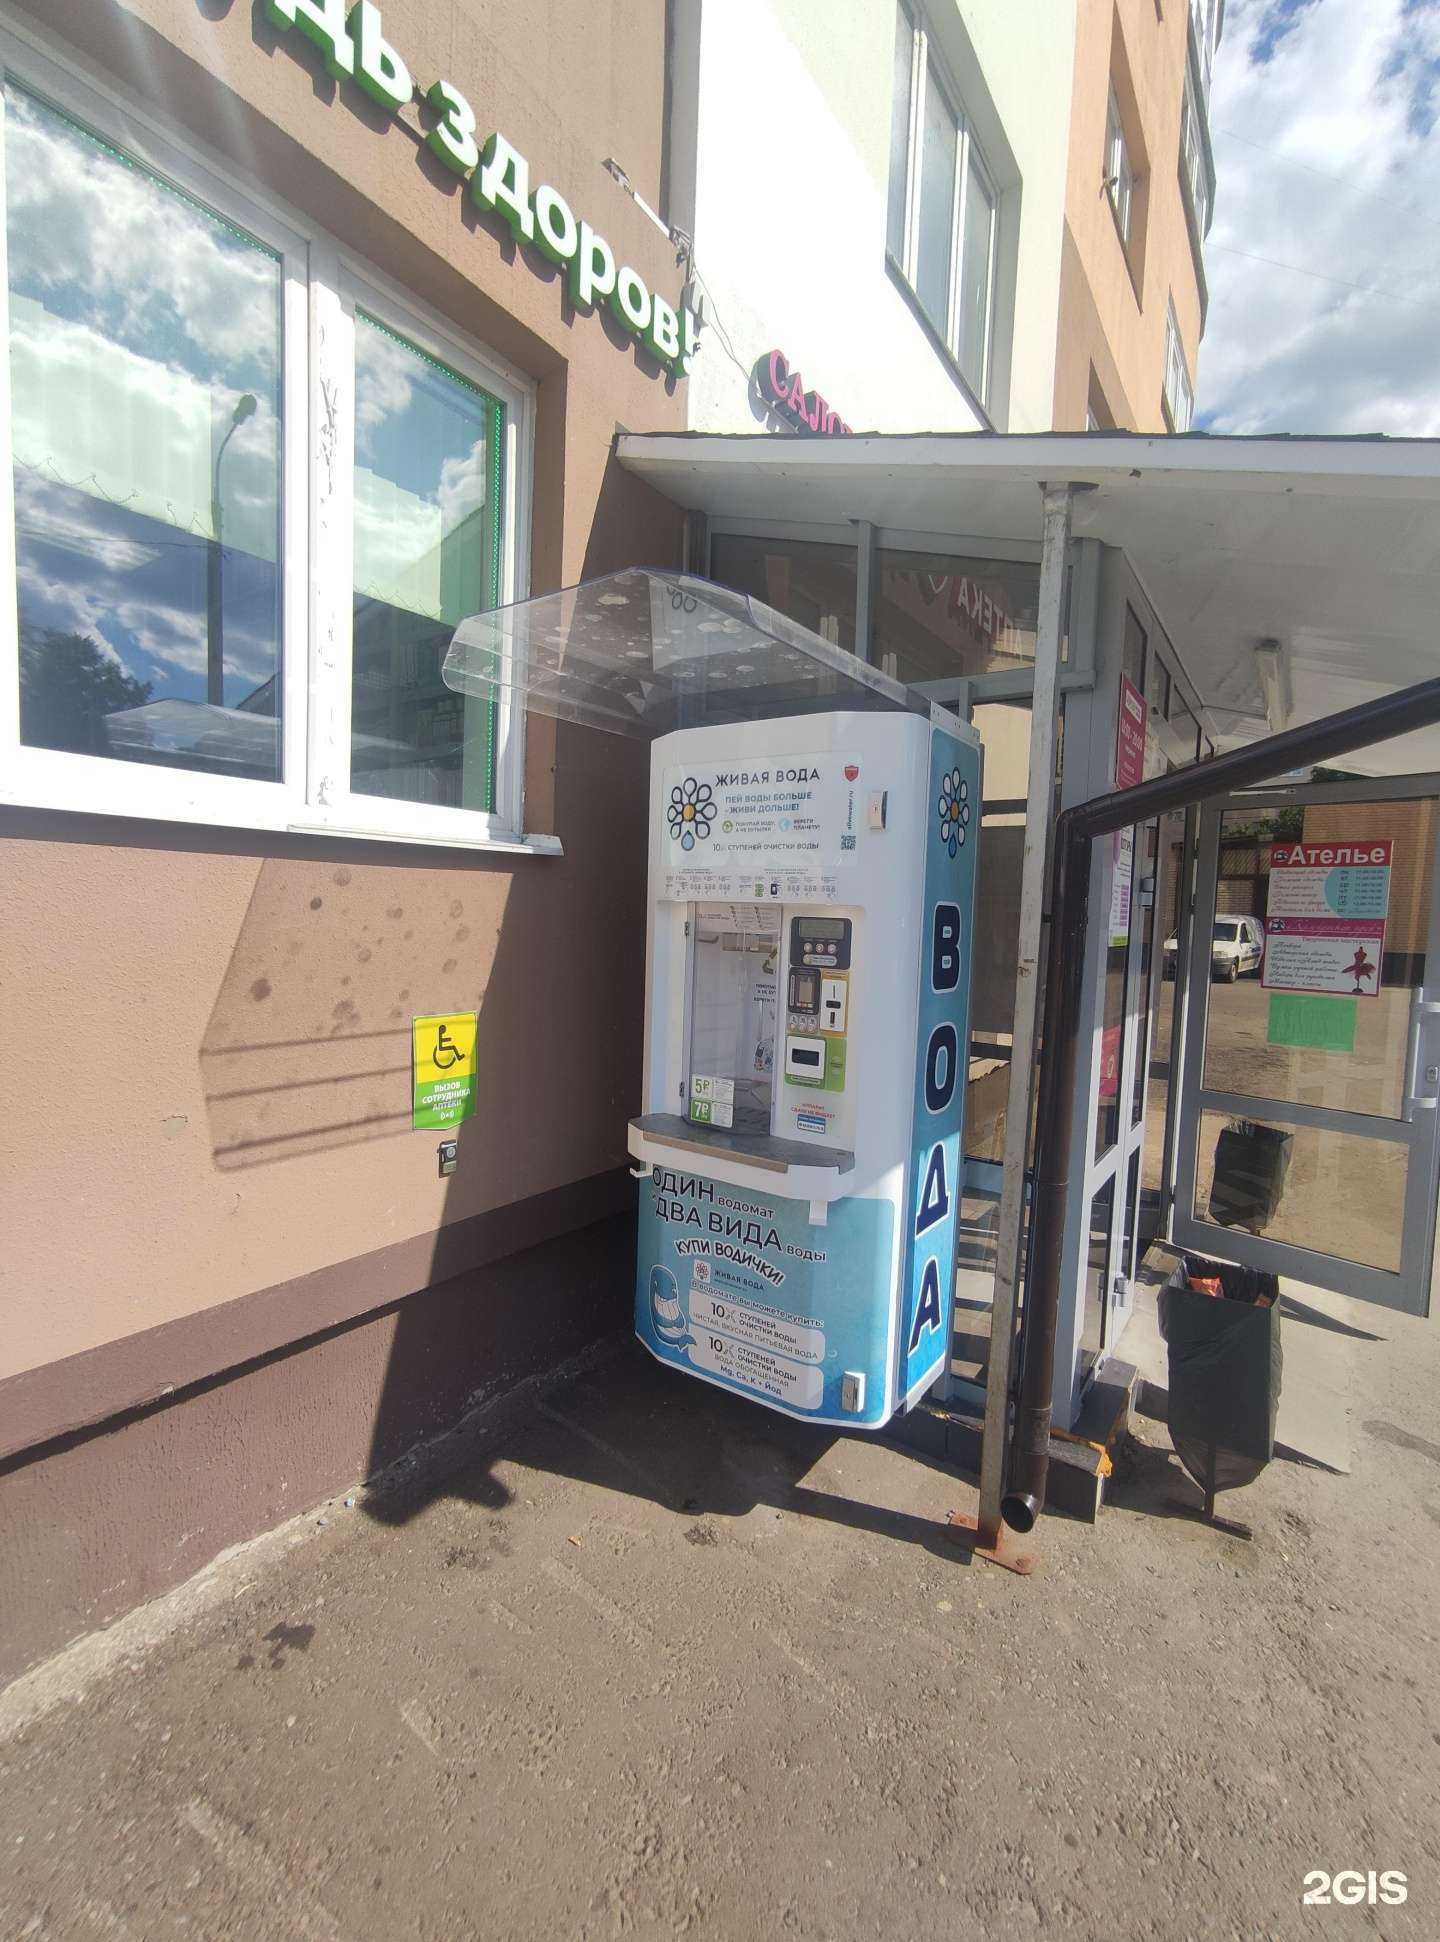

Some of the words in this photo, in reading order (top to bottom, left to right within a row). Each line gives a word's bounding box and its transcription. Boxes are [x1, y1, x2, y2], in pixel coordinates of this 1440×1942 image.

[715, 771, 770, 787] ЖИВАЯ
[776, 768, 820, 783] ВОДА
[725, 794, 743, 804] ПЕЙ
[745, 793, 771, 803] ВОДЫ
[773, 791, 812, 801] БОЛЬШЕ
[730, 805, 756, 814] ЖИВИ
[758, 803, 800, 814] ДОЛЬШЕ!
[727, 843, 762, 851] СТУПЕНЕЙ
[797, 842, 819, 850] ВОДЫ
[1287, 845, 1385, 865] Ателье
[422, 1088, 471, 1104] СОТРУДНИКА
[433, 1081, 461, 1093] ВЫЗОВ
[432, 1099, 462, 1112] АПТЕКИ
[907, 901, 961, 1356] ВОДА
[652, 1167, 714, 1203] ОДИН
[718, 1197, 775, 1219] водомат
[655, 1197, 703, 1229] ДВА
[708, 1211, 783, 1252] ВИДА
[786, 1245, 826, 1262] воды
[675, 1239, 710, 1255] КУПИ
[715, 1242, 785, 1286] ВОДИЧКИ!
[714, 1270, 741, 1283] ЖИВАЯ
[743, 1279, 765, 1290] ВОДА
[710, 1302, 725, 1318] 10
[739, 1312, 776, 1329] СТУПЕНЕЙ
[752, 1302, 785, 1318] можете
[787, 1314, 825, 1327] купить:
[739, 1319, 773, 1335] ОЧИСТКИ
[774, 1331, 797, 1344] ВОДЫ
[709, 1336, 723, 1352] 10
[737, 1347, 776, 1366] СТУПЕНЕЙ
[794, 1350, 818, 1359] ВОДА
[737, 1354, 772, 1373] ОЧИСТКИ
[773, 1367, 797, 1382] ВОДЫ
[764, 1381, 782, 1395] Йод
